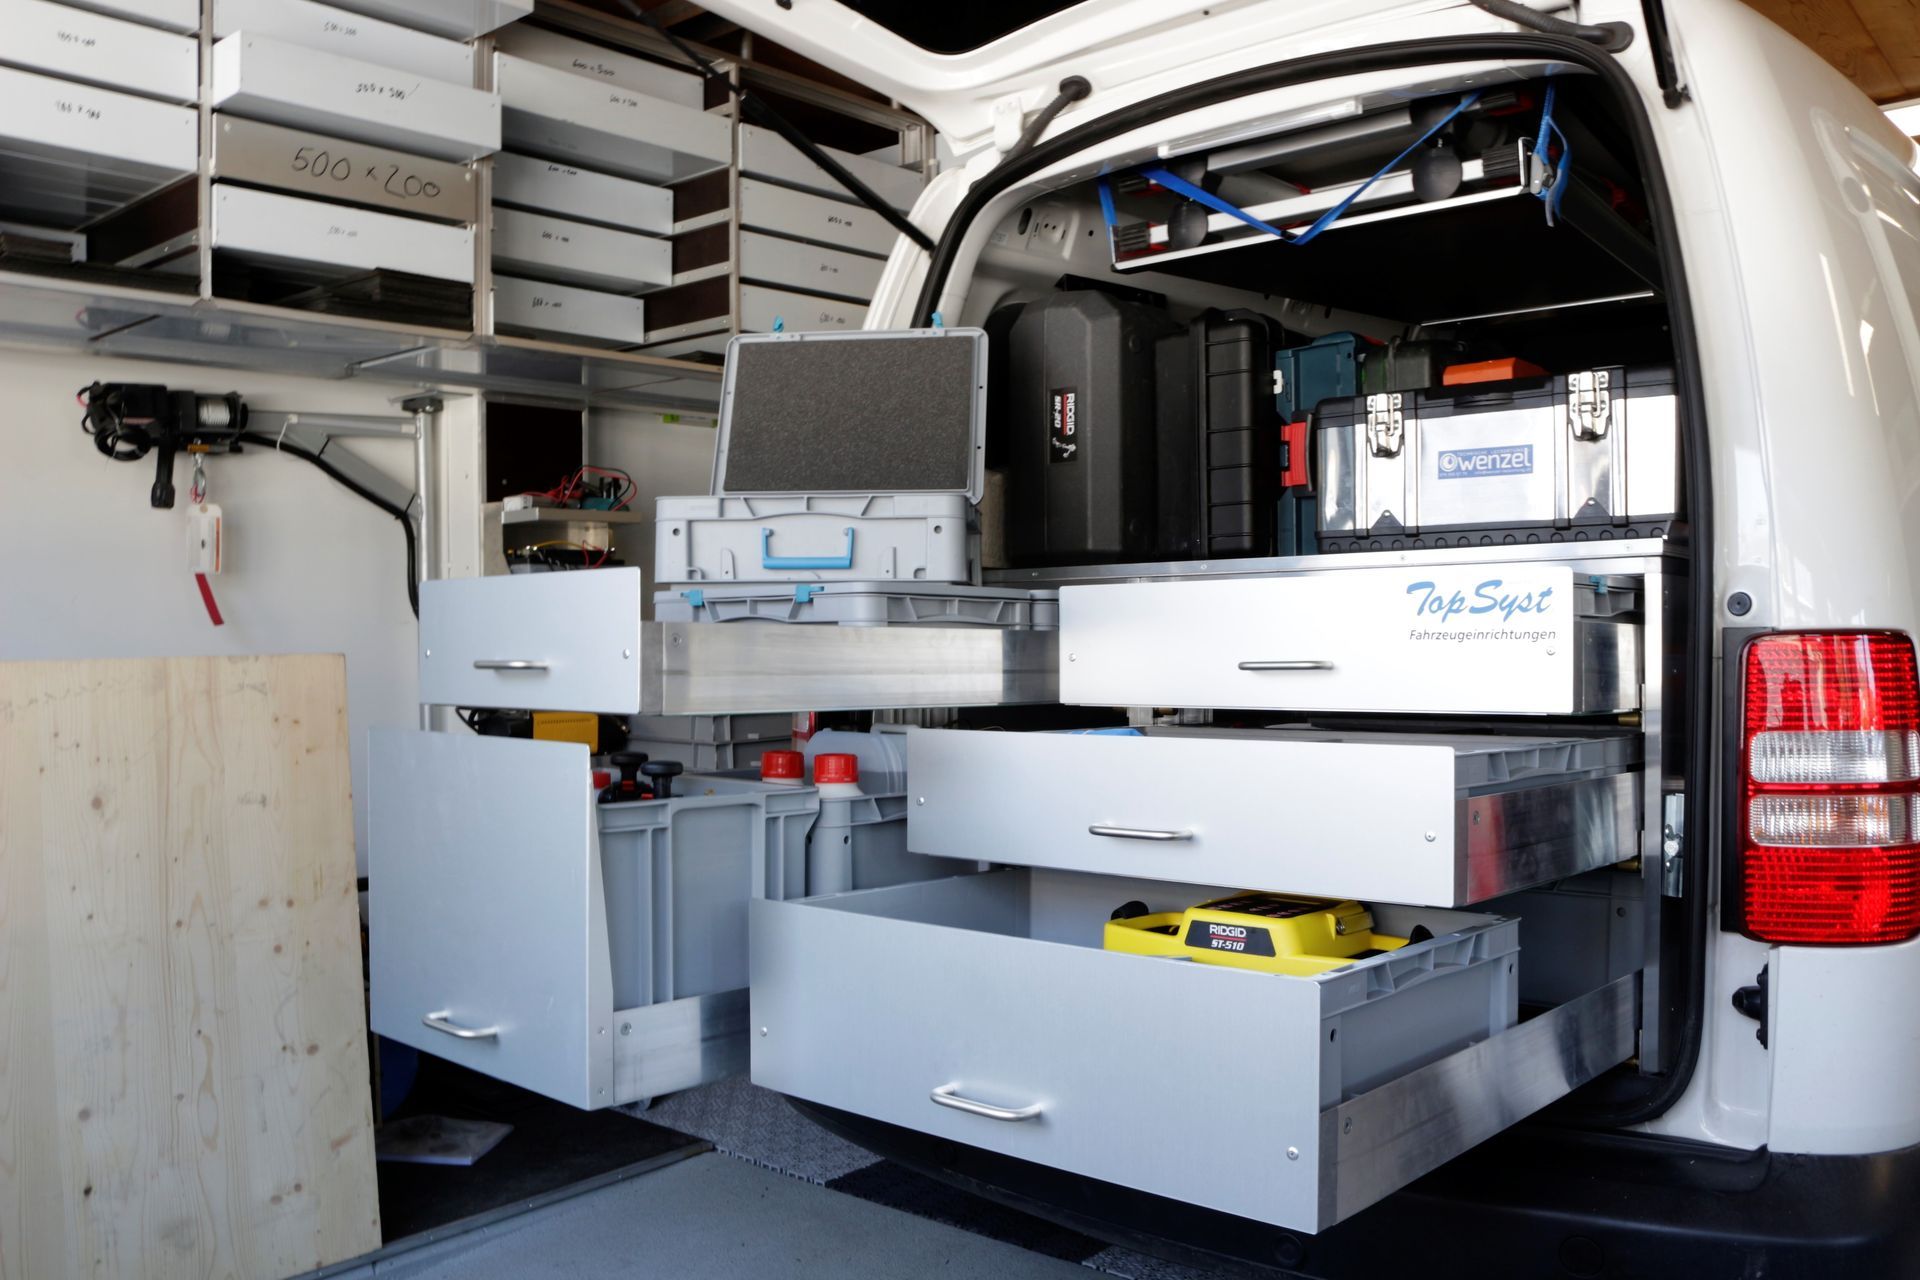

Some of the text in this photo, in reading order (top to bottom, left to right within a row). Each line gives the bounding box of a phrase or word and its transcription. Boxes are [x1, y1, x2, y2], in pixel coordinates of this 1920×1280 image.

[291, 147, 351, 182] 500
[383, 163, 441, 199] 200
[1066, 393, 1075, 435] RIDGID
[1458, 447, 1532, 471] wenzel
[1409, 629, 1557, 643] Fahrzeugeinrichtungen
[1209, 924, 1247, 938] RIDGID
[1211, 939, 1245, 951] ST-510
